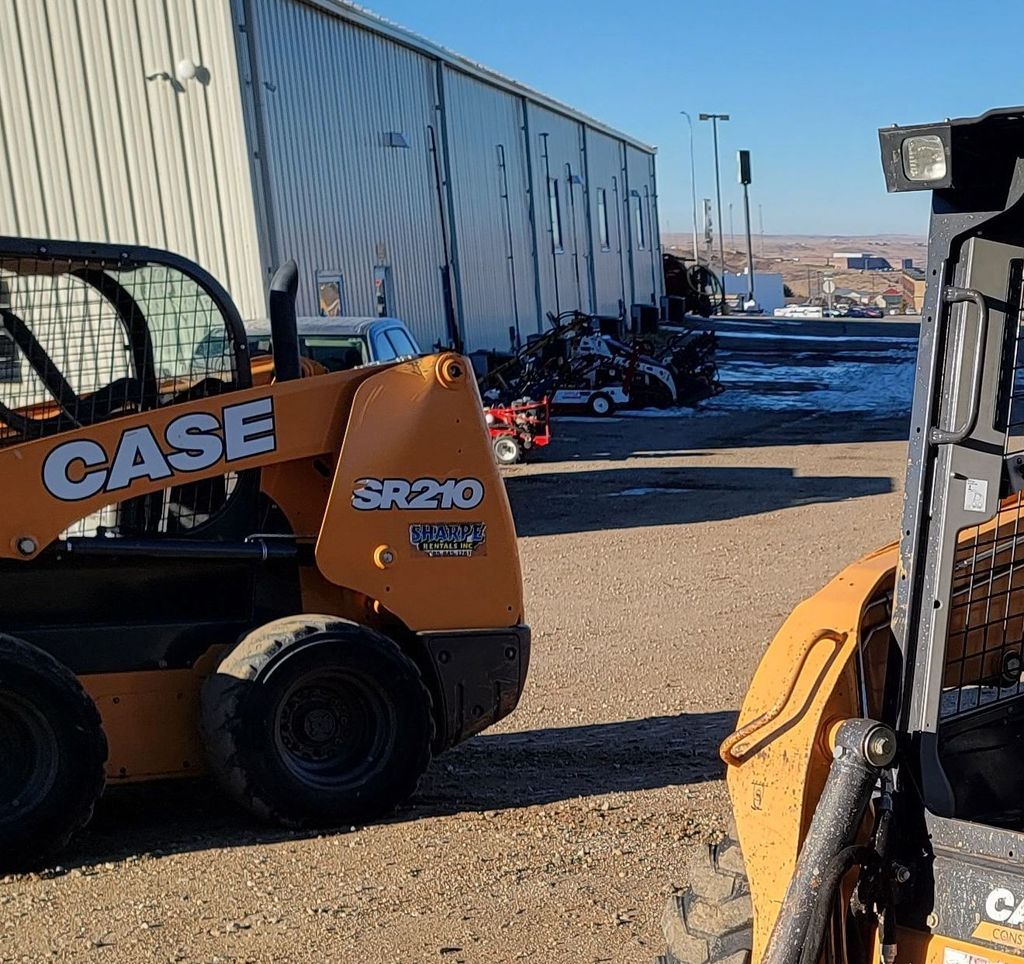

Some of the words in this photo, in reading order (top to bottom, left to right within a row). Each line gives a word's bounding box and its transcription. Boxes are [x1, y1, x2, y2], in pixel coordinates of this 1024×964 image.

[42, 396, 276, 501] CASE
[351, 477, 485, 511] SR210
[410, 523, 486, 544] SHARPE
[422, 543, 458, 551] RENTALS
